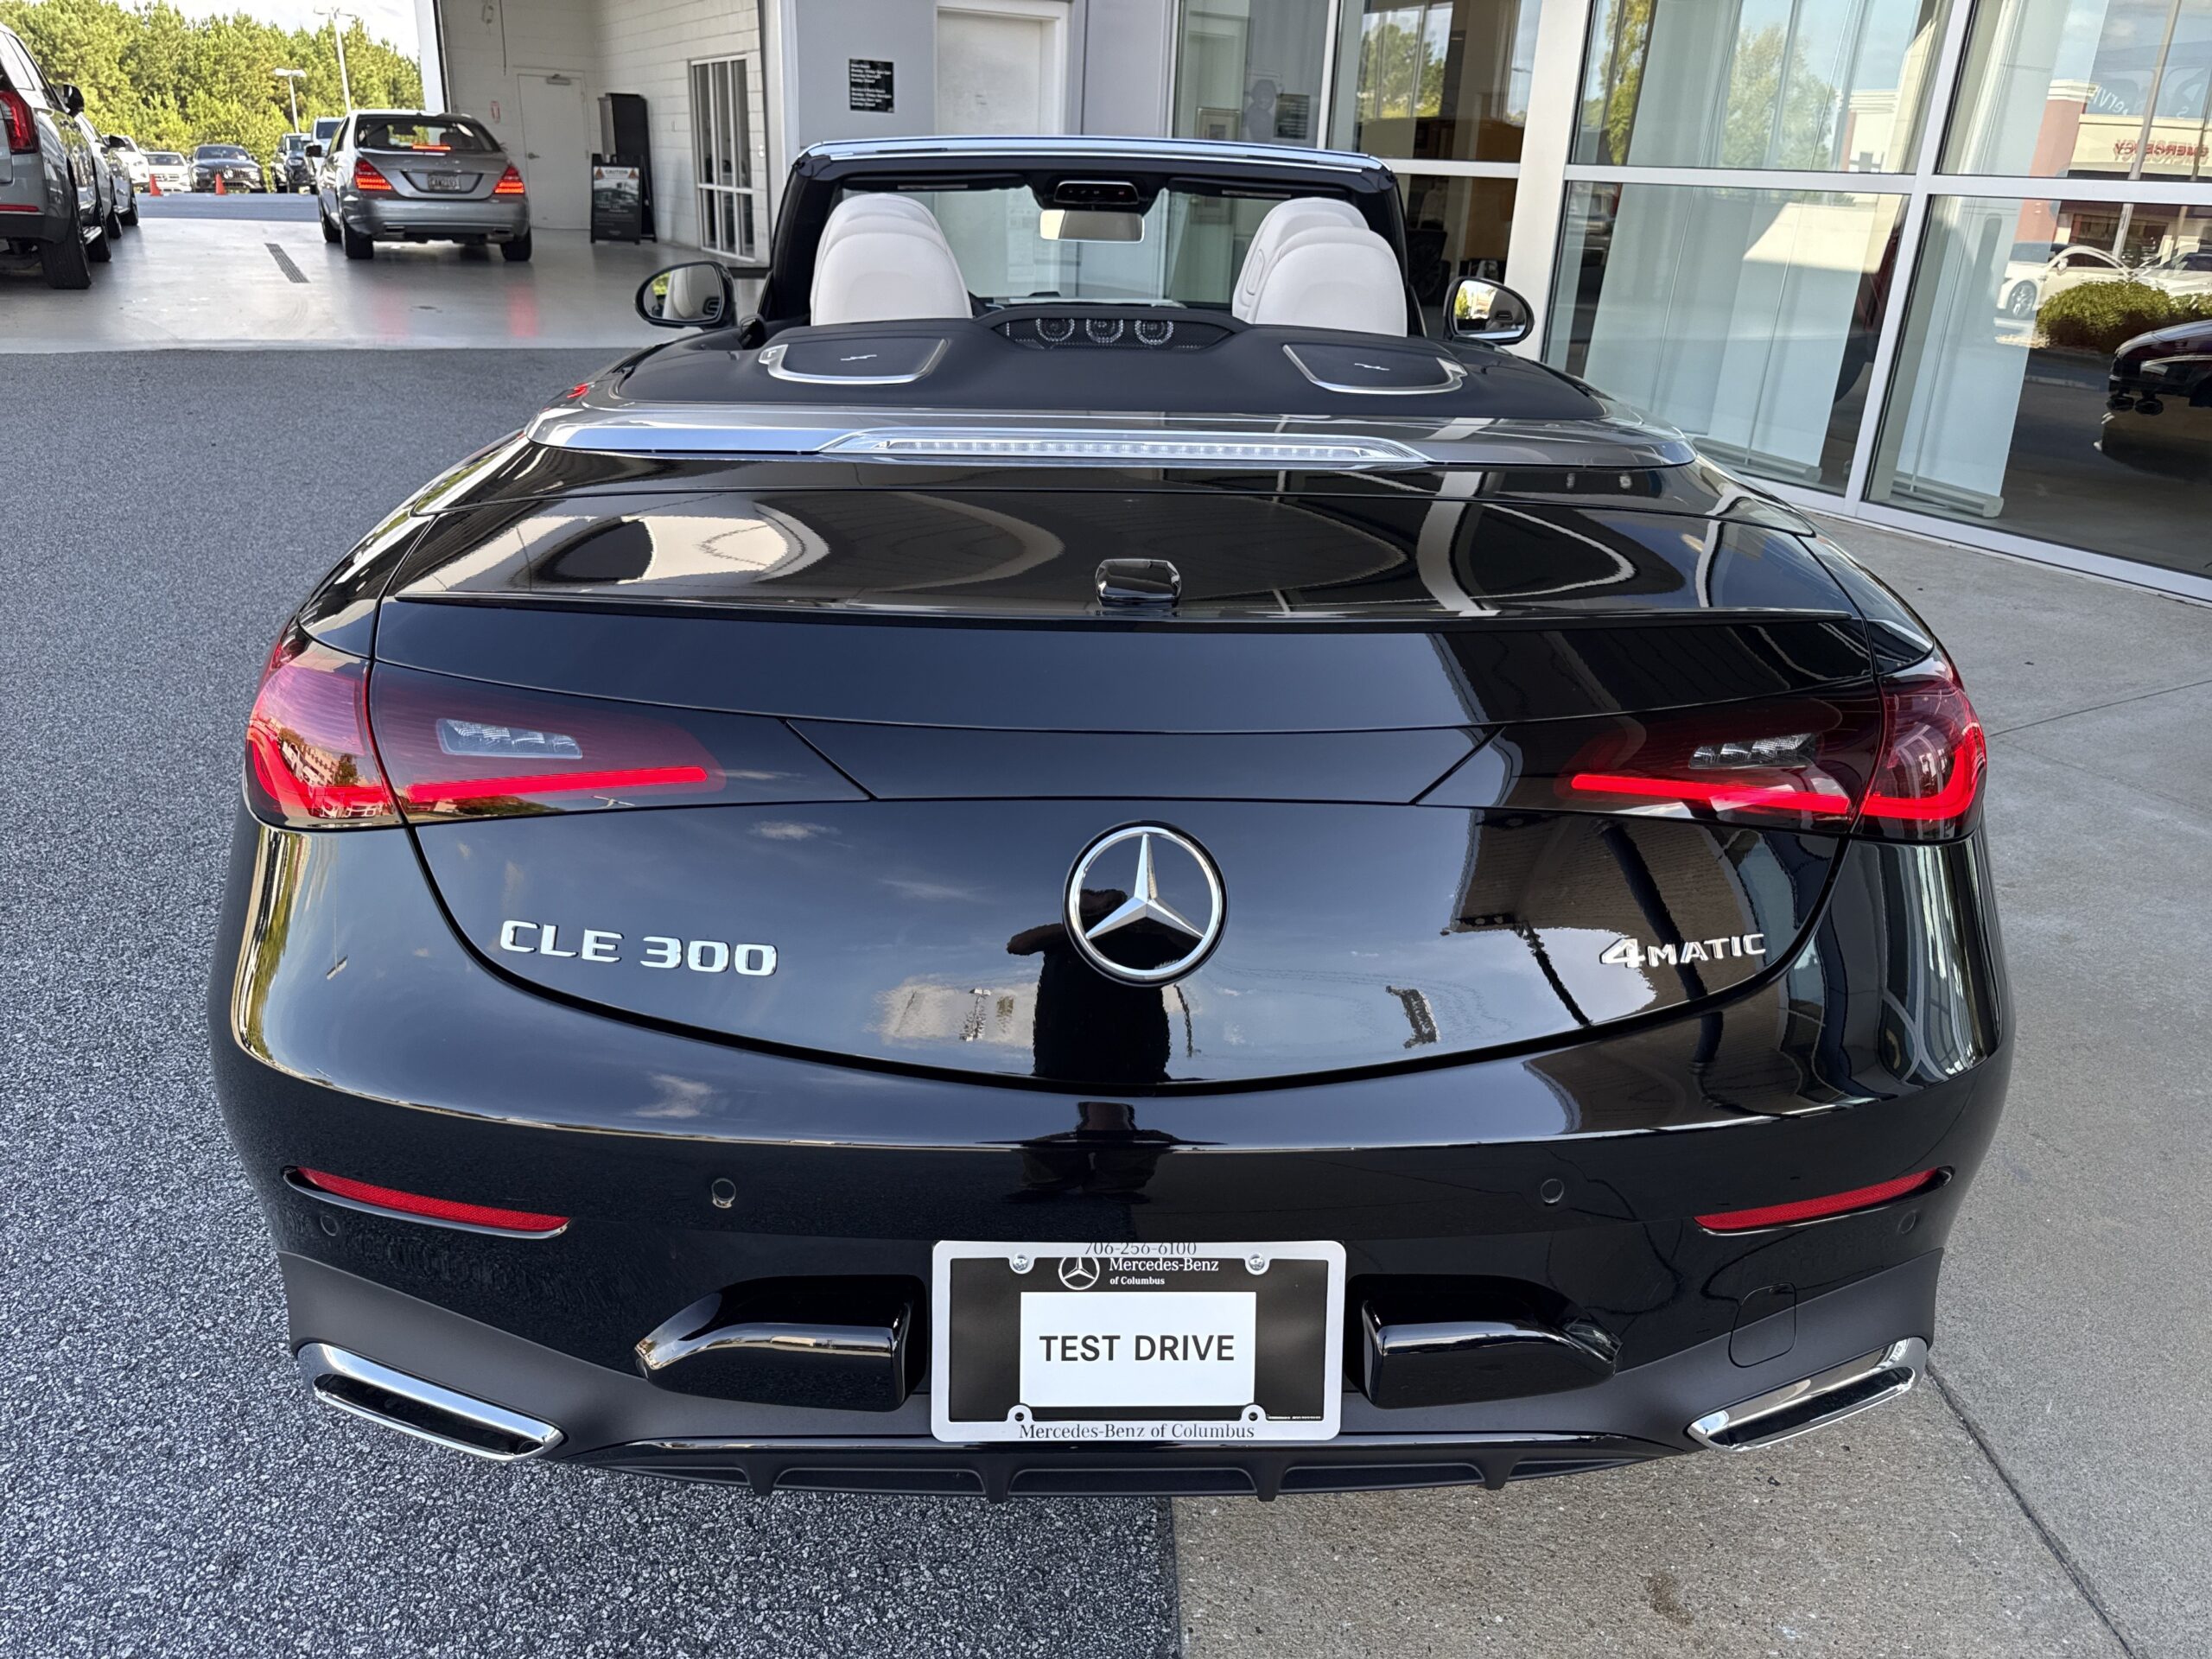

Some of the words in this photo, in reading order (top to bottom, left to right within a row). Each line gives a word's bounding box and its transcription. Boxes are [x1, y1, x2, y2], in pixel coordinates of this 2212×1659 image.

[500, 919, 625, 963] CLE
[639, 936, 778, 977] 300
[1599, 933, 1766, 968] 4MATIC
[1084, 1242, 1197, 1255] 706-256-6100
[1109, 1257, 1219, 1272] Mercedes-Benz
[1109, 1276, 1120, 1285] of
[1121, 1276, 1166, 1285] Columbus
[1039, 1335, 1122, 1362] TEST
[1135, 1334, 1235, 1361] DRIVE
[1019, 1423, 1146, 1439] Mercedes-Benz
[1151, 1423, 1167, 1438] of
[1171, 1423, 1255, 1438] Columbus
